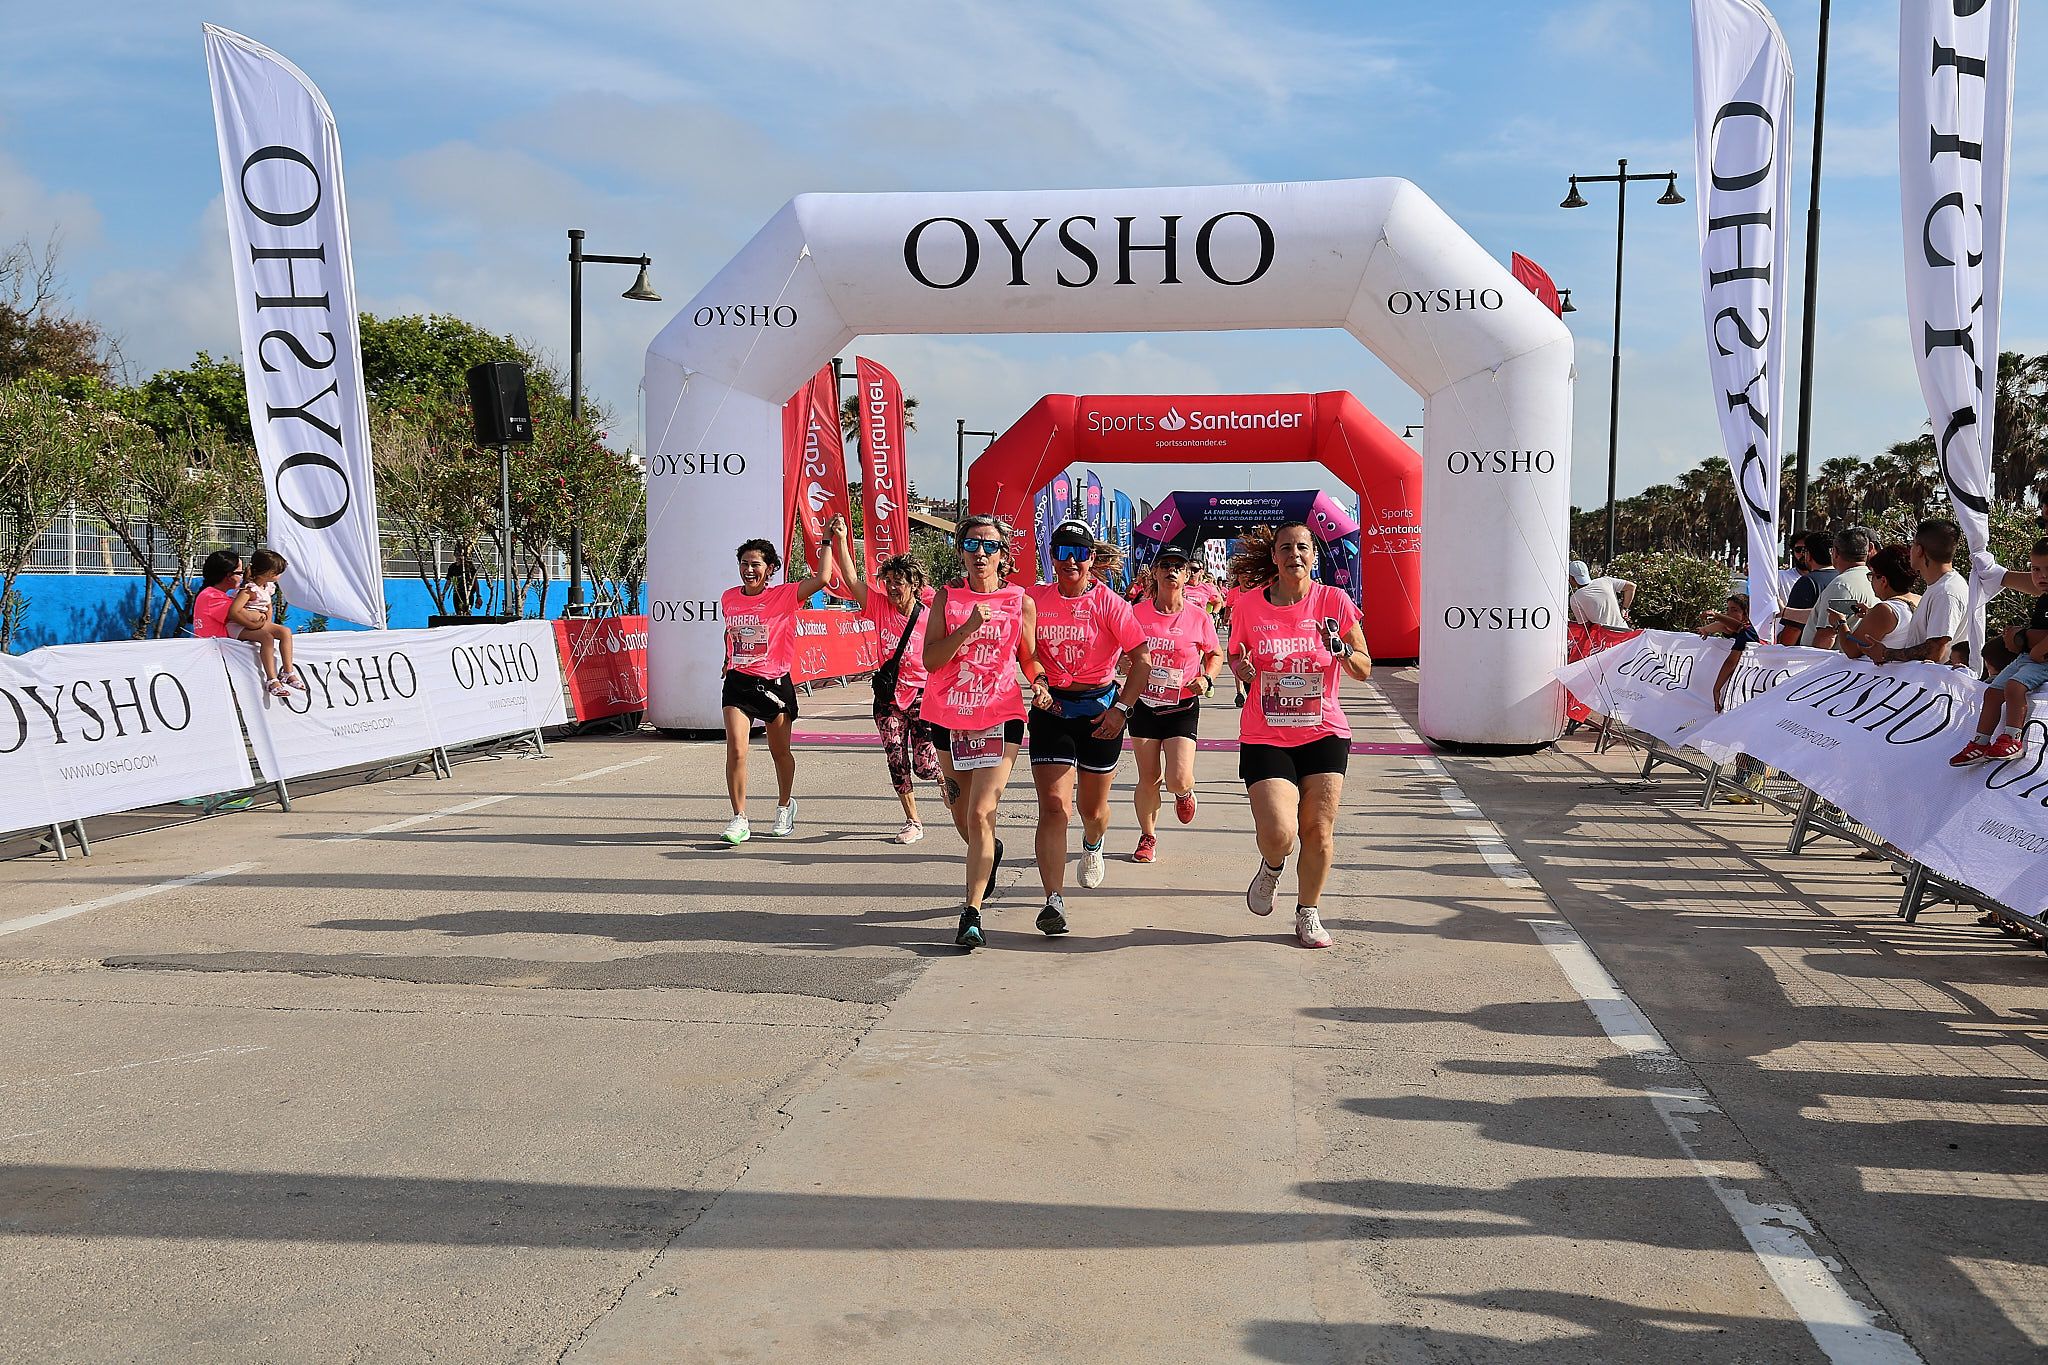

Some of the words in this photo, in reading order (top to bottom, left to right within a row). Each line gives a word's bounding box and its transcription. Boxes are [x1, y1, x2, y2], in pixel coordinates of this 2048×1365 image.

[903, 211, 1275, 290] OYSHO
[1387, 288, 1503, 315] OYSHO
[693, 304, 798, 328] OYSHO
[1087, 411, 1155, 436] Sports
[1189, 408, 1303, 431] Santander
[1155, 438, 1228, 449] sportssantander.es
[651, 452, 746, 477] OYSHO
[1447, 450, 1555, 475] OYSHO
[1219, 498, 1252, 506] octopus
[1253, 499, 1281, 507] energy
[1381, 508, 1414, 520] Sports
[652, 600, 719, 623] OYSH
[1444, 606, 1551, 630] OYSHO
[618, 628, 648, 651] Santa
[1037, 625, 1085, 641] CARRERA
[1252, 624, 1279, 632] OYSHO
[1259, 637, 1317, 655] CARRERA
[451, 642, 539, 690] OYSHO
[279, 651, 417, 715] OYSHO
[1148, 684, 1165, 693] 016
[1280, 697, 1304, 706] 016
[1786, 670, 1952, 745] OYSHO
[331, 717, 396, 738] WWW.OYSHO.COM
[970, 738, 986, 749] 016
[60, 755, 158, 780] WWW.OYSHO.COM
